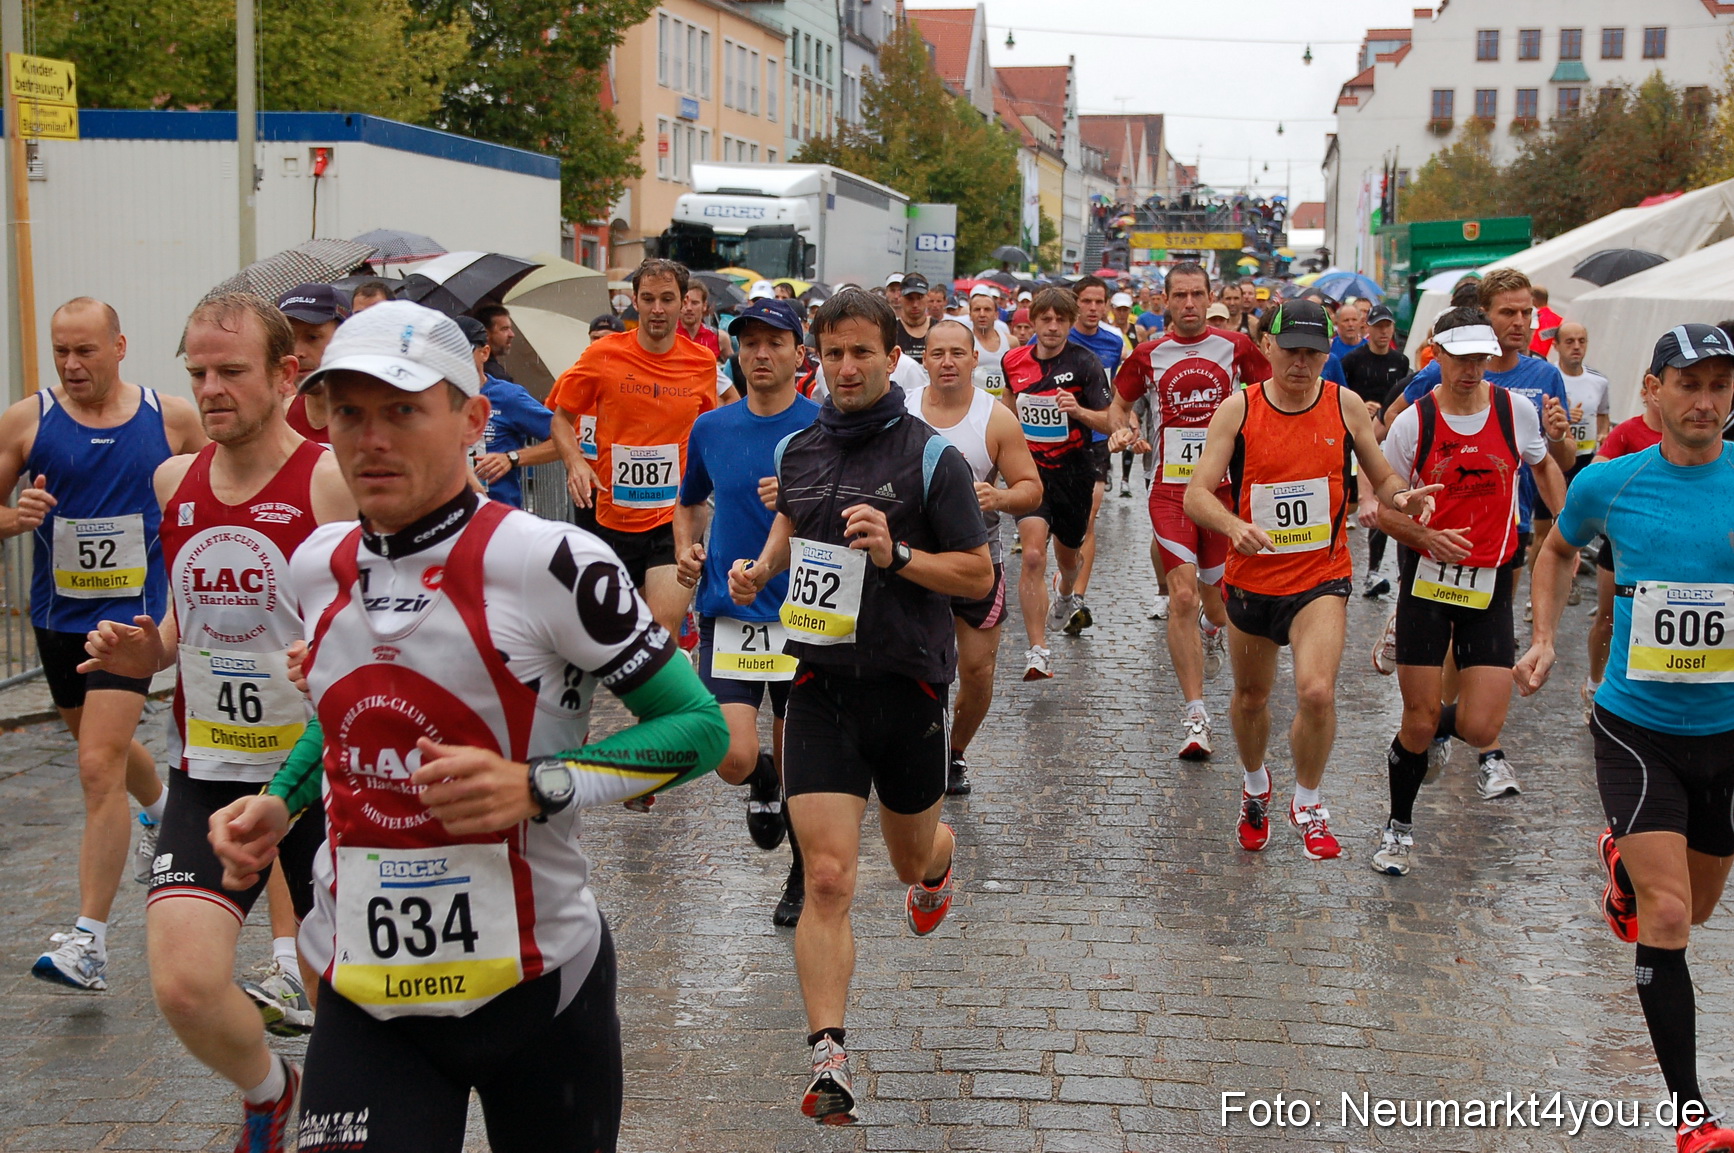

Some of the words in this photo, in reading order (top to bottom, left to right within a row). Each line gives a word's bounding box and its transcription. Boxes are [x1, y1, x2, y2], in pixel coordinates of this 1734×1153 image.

[704, 205, 766, 219] BOCK
[1165, 236, 1204, 247] START
[620, 383, 652, 395] EURO
[662, 386, 694, 398] POLES
[985, 376, 1001, 389] 63
[1172, 388, 1218, 405] LAC
[1021, 406, 1062, 425] 3399
[618, 461, 673, 486] 2087
[628, 490, 665, 499] Michael
[875, 489, 896, 498] adidas
[1273, 485, 1306, 495] BOCK
[249, 504, 274, 514] TEAM
[1276, 500, 1308, 528] 90
[75, 522, 114, 532] BOCK
[413, 508, 465, 543] cervélo
[1274, 531, 1312, 545] Helmut
[78, 539, 117, 570] 52
[802, 546, 833, 560] BOCK
[71, 575, 129, 587] Karlheinz
[192, 568, 264, 593] LAC
[1437, 561, 1479, 588] 111
[792, 566, 841, 610] 652
[1433, 588, 1469, 603] Jochen
[1667, 589, 1714, 600] BOCK
[198, 595, 260, 606] Harlekin
[788, 611, 826, 631] Jochen
[1655, 609, 1725, 647] 606
[201, 623, 267, 643] MISTELBACH
[741, 624, 770, 652] 21
[210, 656, 257, 670] BOCK
[737, 658, 775, 670] Hubert
[1666, 655, 1707, 669] Josef
[217, 681, 263, 724] 46
[211, 728, 279, 748] Christian
[361, 802, 433, 830] MISTELBAC
[380, 858, 448, 878] BOCK
[367, 892, 479, 959] 634
[342, 951, 349, 962] A
[385, 974, 466, 999] Lorenz
